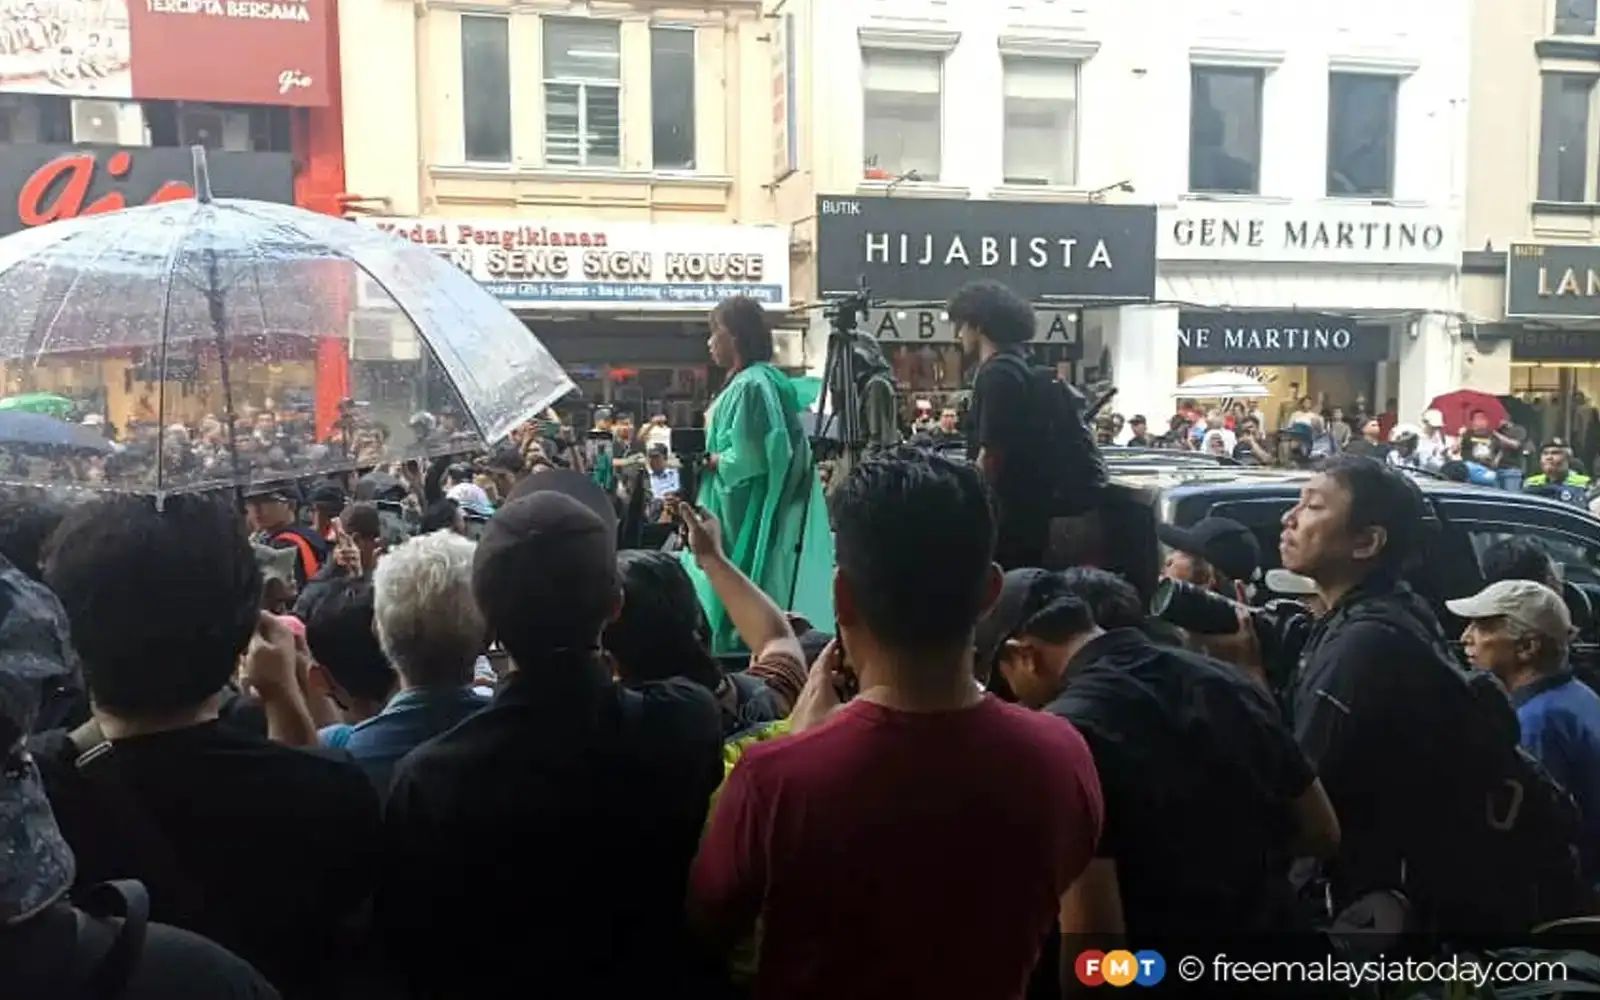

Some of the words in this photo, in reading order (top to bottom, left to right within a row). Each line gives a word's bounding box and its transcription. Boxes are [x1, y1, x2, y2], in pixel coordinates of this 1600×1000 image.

[146, 0, 225, 15] TERCIPTA
[226, 0, 311, 22] BERSAMA
[821, 199, 860, 215] BUTIK
[457, 224, 607, 250] Pengiklanan
[1173, 217, 1265, 248] GENE
[1284, 220, 1445, 250] MARTINO
[865, 232, 1114, 270] HIJABISTA
[487, 249, 570, 281] SENG
[583, 251, 652, 281] SIGN
[665, 252, 764, 282] HOUSE
[1224, 328, 1350, 349] MARTINO
